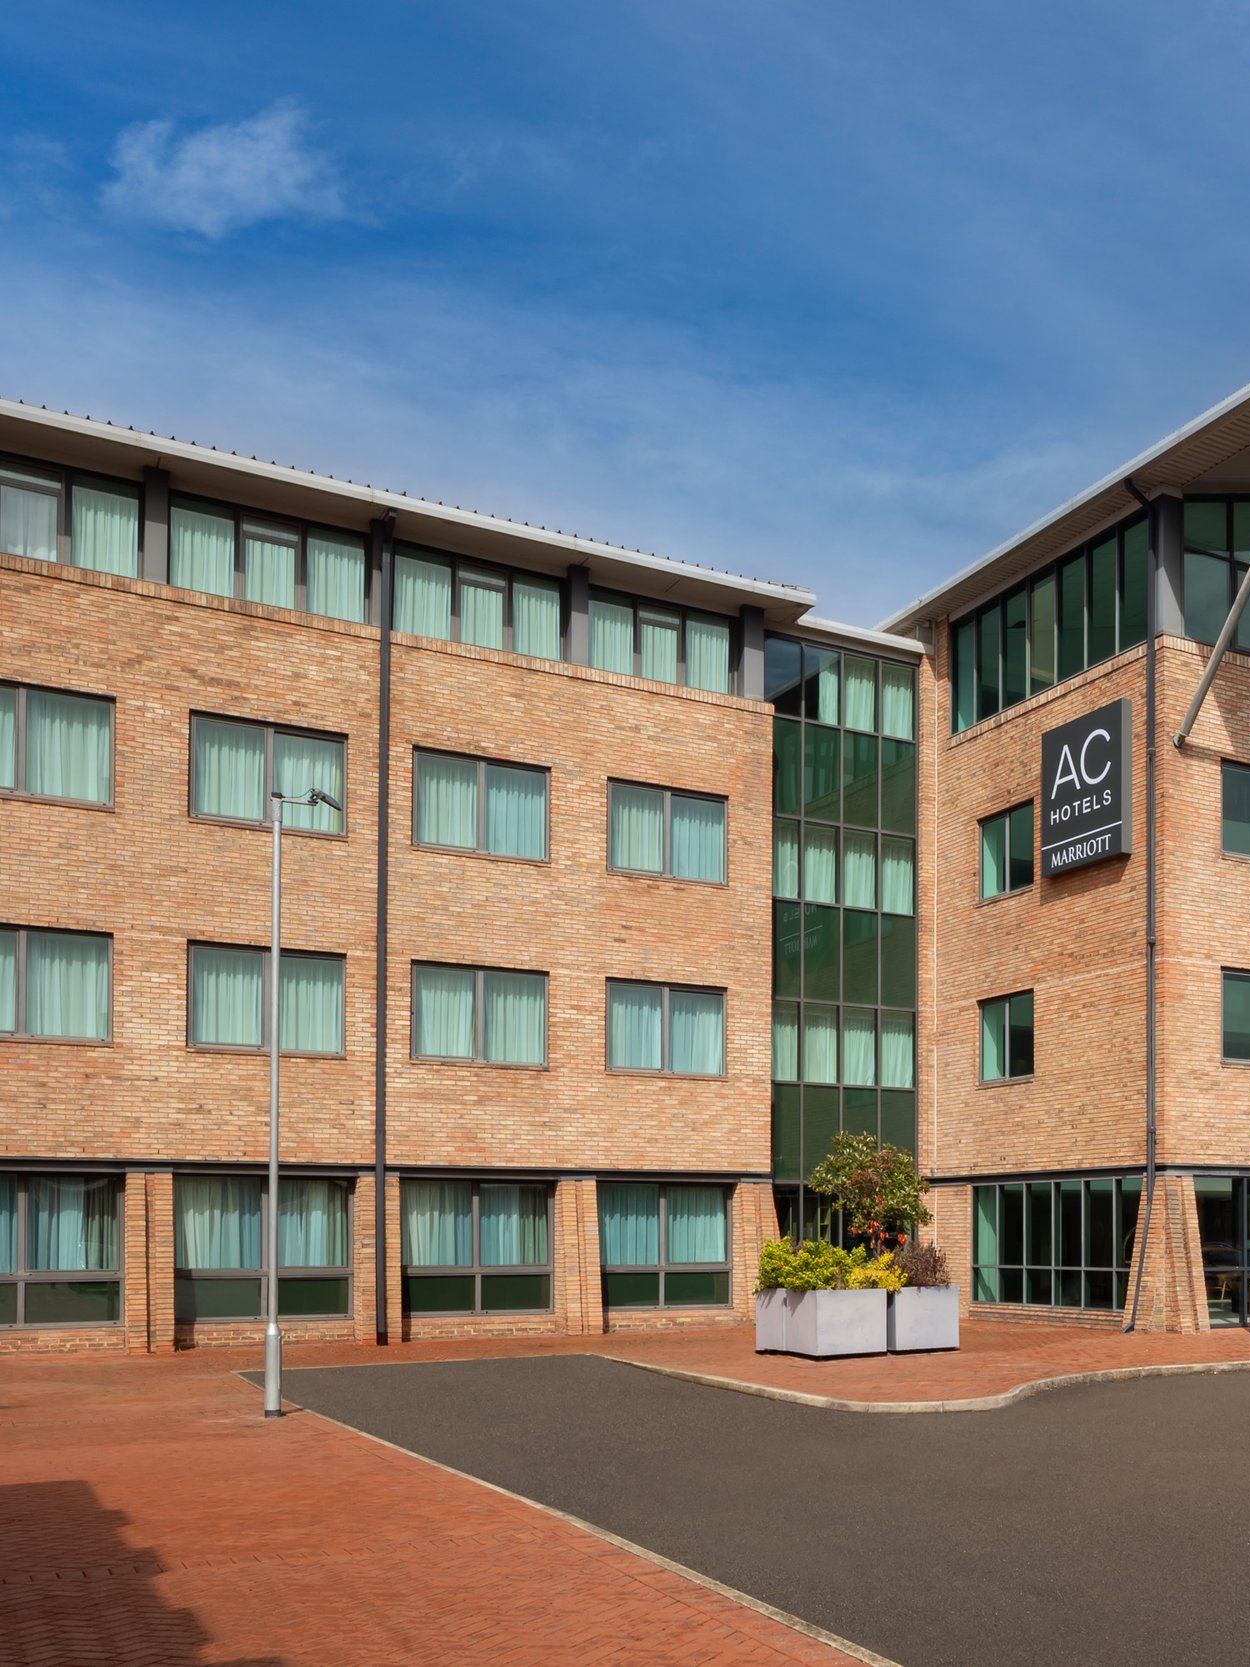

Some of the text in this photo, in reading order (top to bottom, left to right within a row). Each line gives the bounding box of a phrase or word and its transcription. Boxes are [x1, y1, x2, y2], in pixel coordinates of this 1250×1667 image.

[1051, 728, 1112, 800] AC
[1050, 789, 1112, 826] HOTELS
[1051, 833, 1112, 869] MARRIOTT
